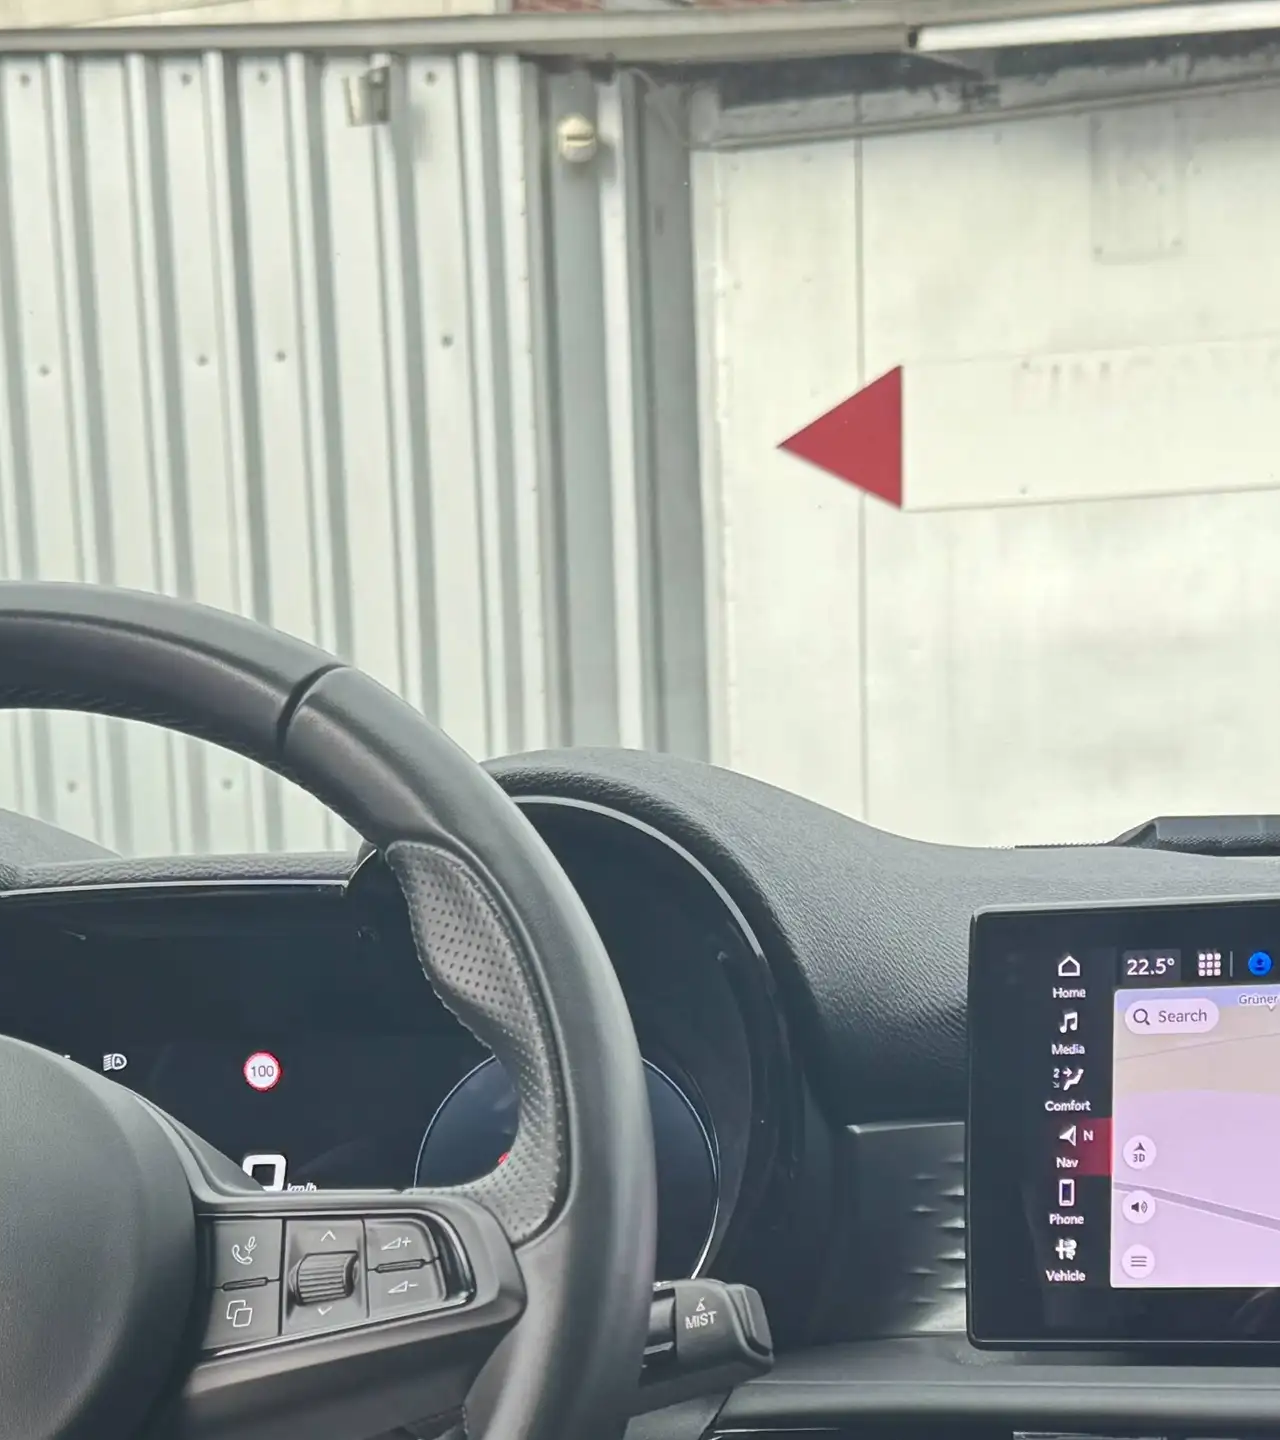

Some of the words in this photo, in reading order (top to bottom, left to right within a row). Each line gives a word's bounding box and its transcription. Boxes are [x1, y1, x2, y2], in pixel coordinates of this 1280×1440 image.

[1126, 957, 1175, 976] 22.5°
[1052, 987, 1086, 999] Home
[1238, 993, 1277, 1005] Grüner
[1158, 1008, 1208, 1024] Search
[1051, 1043, 1085, 1056] Media
[250, 1064, 275, 1078] 100
[1045, 1100, 1091, 1112] Comfort
[1083, 1130, 1094, 1141] N
[1056, 1157, 1078, 1168] Nav
[1133, 1153, 1146, 1163] 3D
[1049, 1213, 1084, 1225] Phone
[1045, 1269, 1086, 1282] Vehicle
[685, 1311, 718, 1330] MIST
